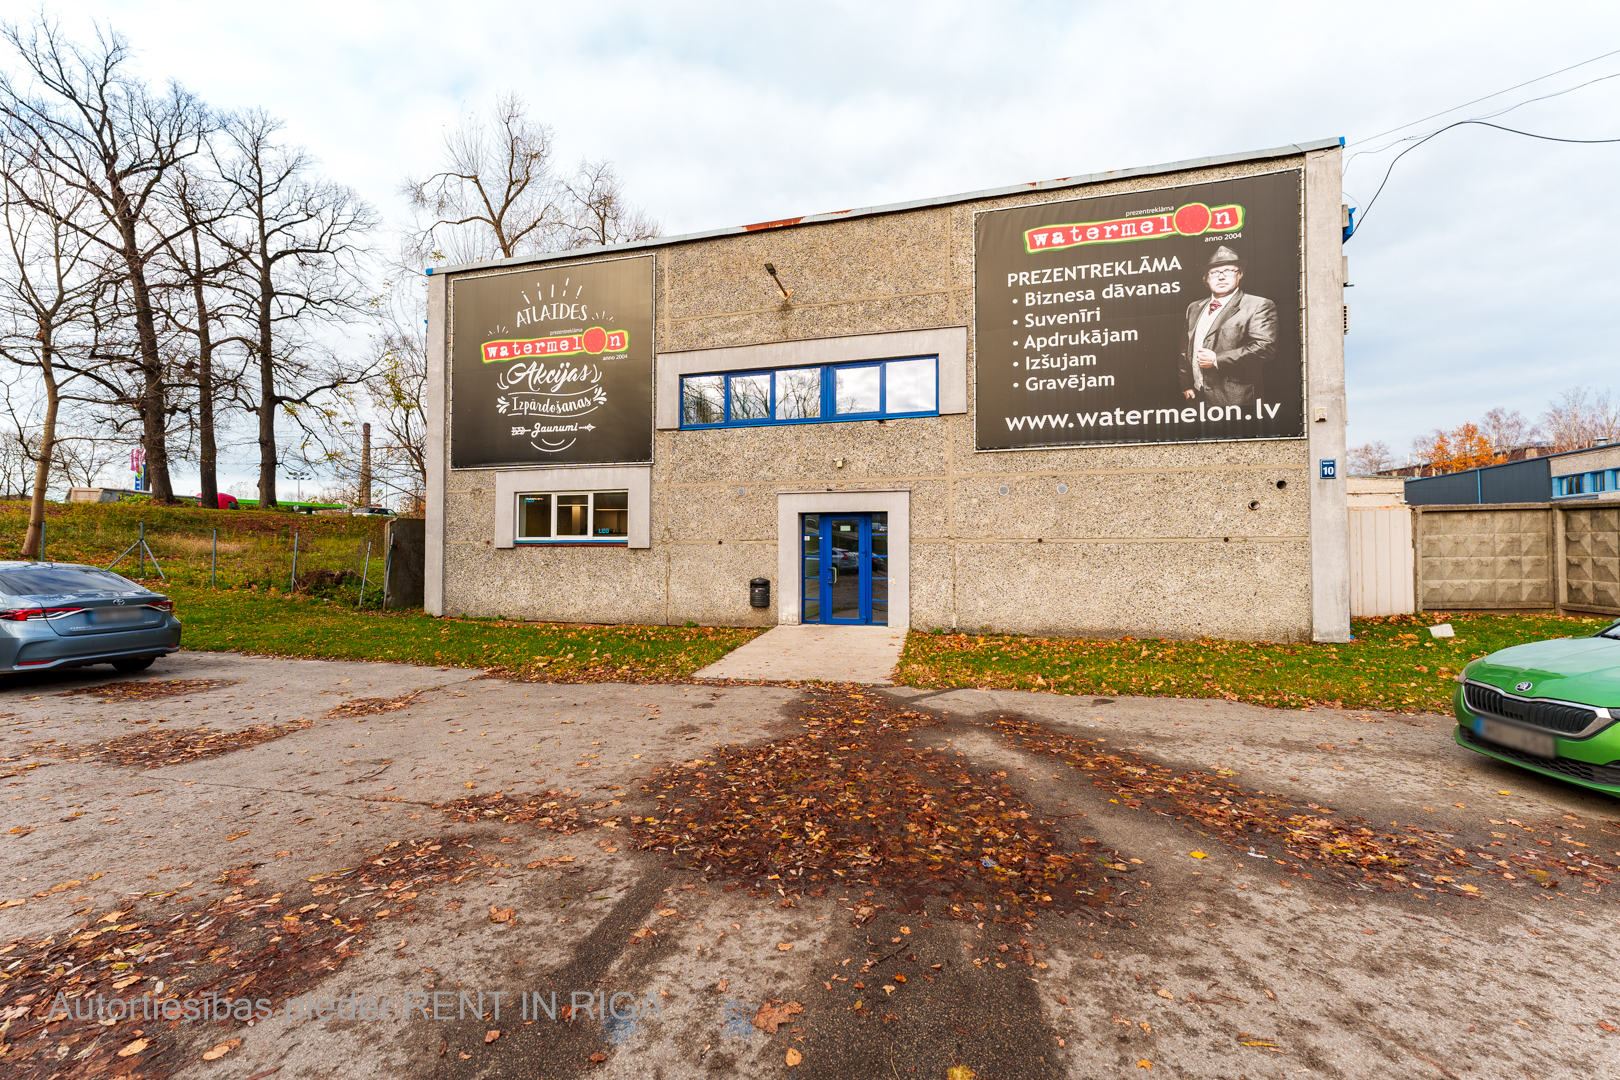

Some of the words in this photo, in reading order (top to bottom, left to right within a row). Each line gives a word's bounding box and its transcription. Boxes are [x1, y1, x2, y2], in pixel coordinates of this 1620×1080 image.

[1224, 232, 1243, 241] 2004
[1007, 255, 1183, 287] PREZENTREKLĀMA
[1024, 287, 1096, 307] Biznesa
[1101, 280, 1181, 300] dāvanas
[516, 303, 588, 328] ATLAIDES
[1024, 307, 1102, 328] Suvenīri
[1023, 328, 1139, 351] Apdrukājam
[1025, 353, 1097, 371] Izšujam
[506, 361, 593, 393] Akcijas
[1025, 374, 1116, 392] Gravējam
[512, 395, 592, 415] Izpārdošanas
[1005, 398, 1282, 432] www.watermelon.lv
[531, 422, 578, 438] Jaunumi
[1322, 466, 1335, 475] 10
